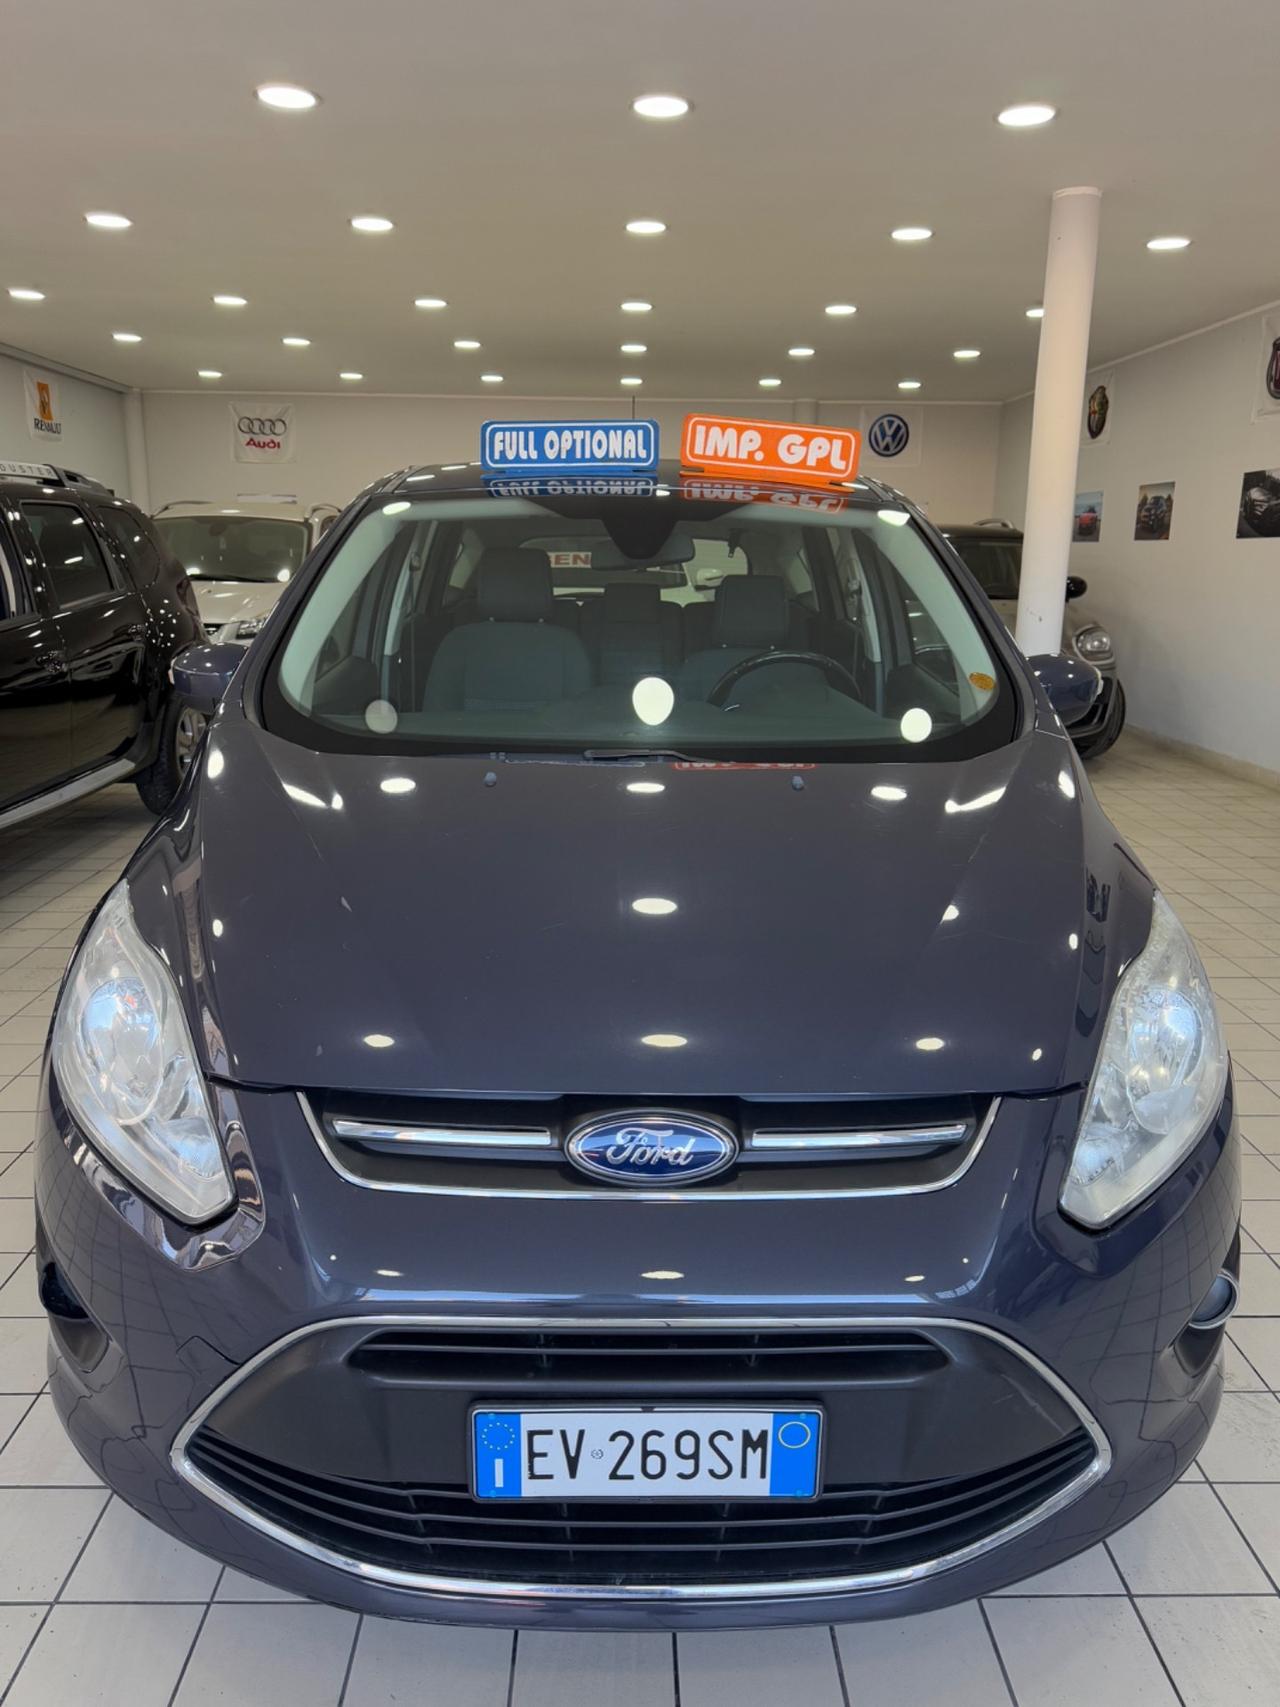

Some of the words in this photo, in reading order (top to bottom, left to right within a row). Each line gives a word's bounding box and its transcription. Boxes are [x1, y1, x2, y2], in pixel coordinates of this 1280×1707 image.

[245, 438, 281, 449] Audi
[494, 431, 538, 460] FULL
[544, 429, 647, 460] OPTIONAL
[694, 425, 765, 462] IMP.
[777, 433, 847, 470] GPL
[606, 1127, 696, 1165] Ford
[526, 1429, 586, 1480] EV
[608, 1429, 769, 1480] 269SM
